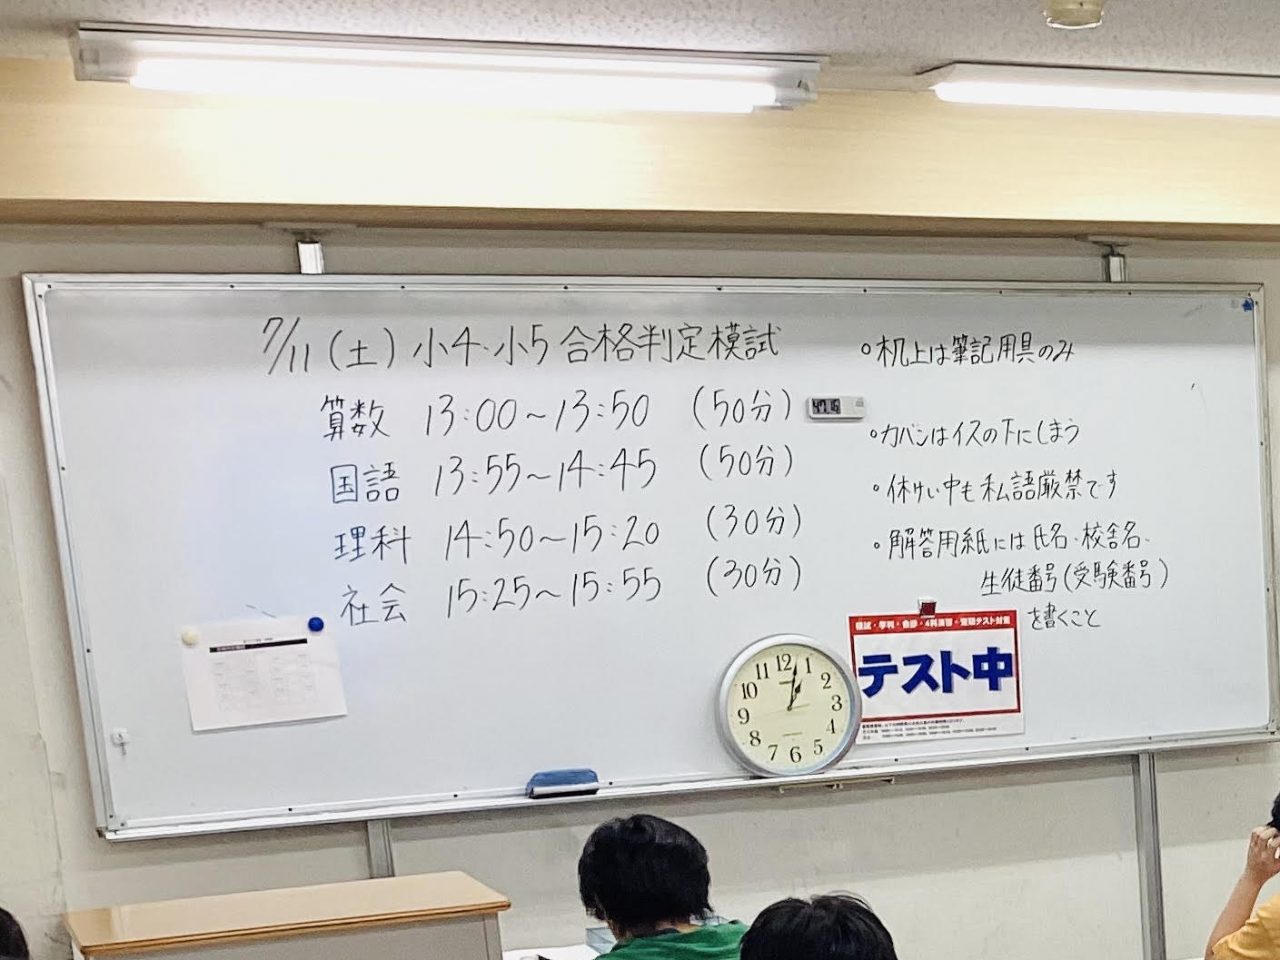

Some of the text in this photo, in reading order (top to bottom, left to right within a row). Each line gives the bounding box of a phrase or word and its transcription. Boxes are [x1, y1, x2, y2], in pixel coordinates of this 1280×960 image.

[559, 320, 782, 364] 合格判定模試
[319, 394, 391, 443] 算数
[692, 385, 791, 431] (50分)
[880, 417, 1080, 449] カバンはイスの下にしまう
[329, 461, 401, 505] 国語
[699, 443, 793, 481] (50分)
[334, 524, 412, 565] 理科
[706, 503, 802, 542] (30分)
[339, 582, 407, 627] 社会
[706, 554, 801, 598] (30分)
[1026, 601, 1101, 631] を書くこと
[756, 662, 770, 681] 11
[775, 653, 793, 673] 12
[805, 657, 813, 674] 1
[858, 646, 1014, 698] テスト中
[741, 681, 759, 700] 10
[820, 672, 832, 690] 2
[831, 694, 843, 712] 3
[737, 707, 750, 725] 9
[825, 718, 836, 735] 4
[749, 730, 762, 747] 8
[813, 739, 823, 756] 5
[767, 744, 779, 761] 7
[789, 746, 802, 764] 6
